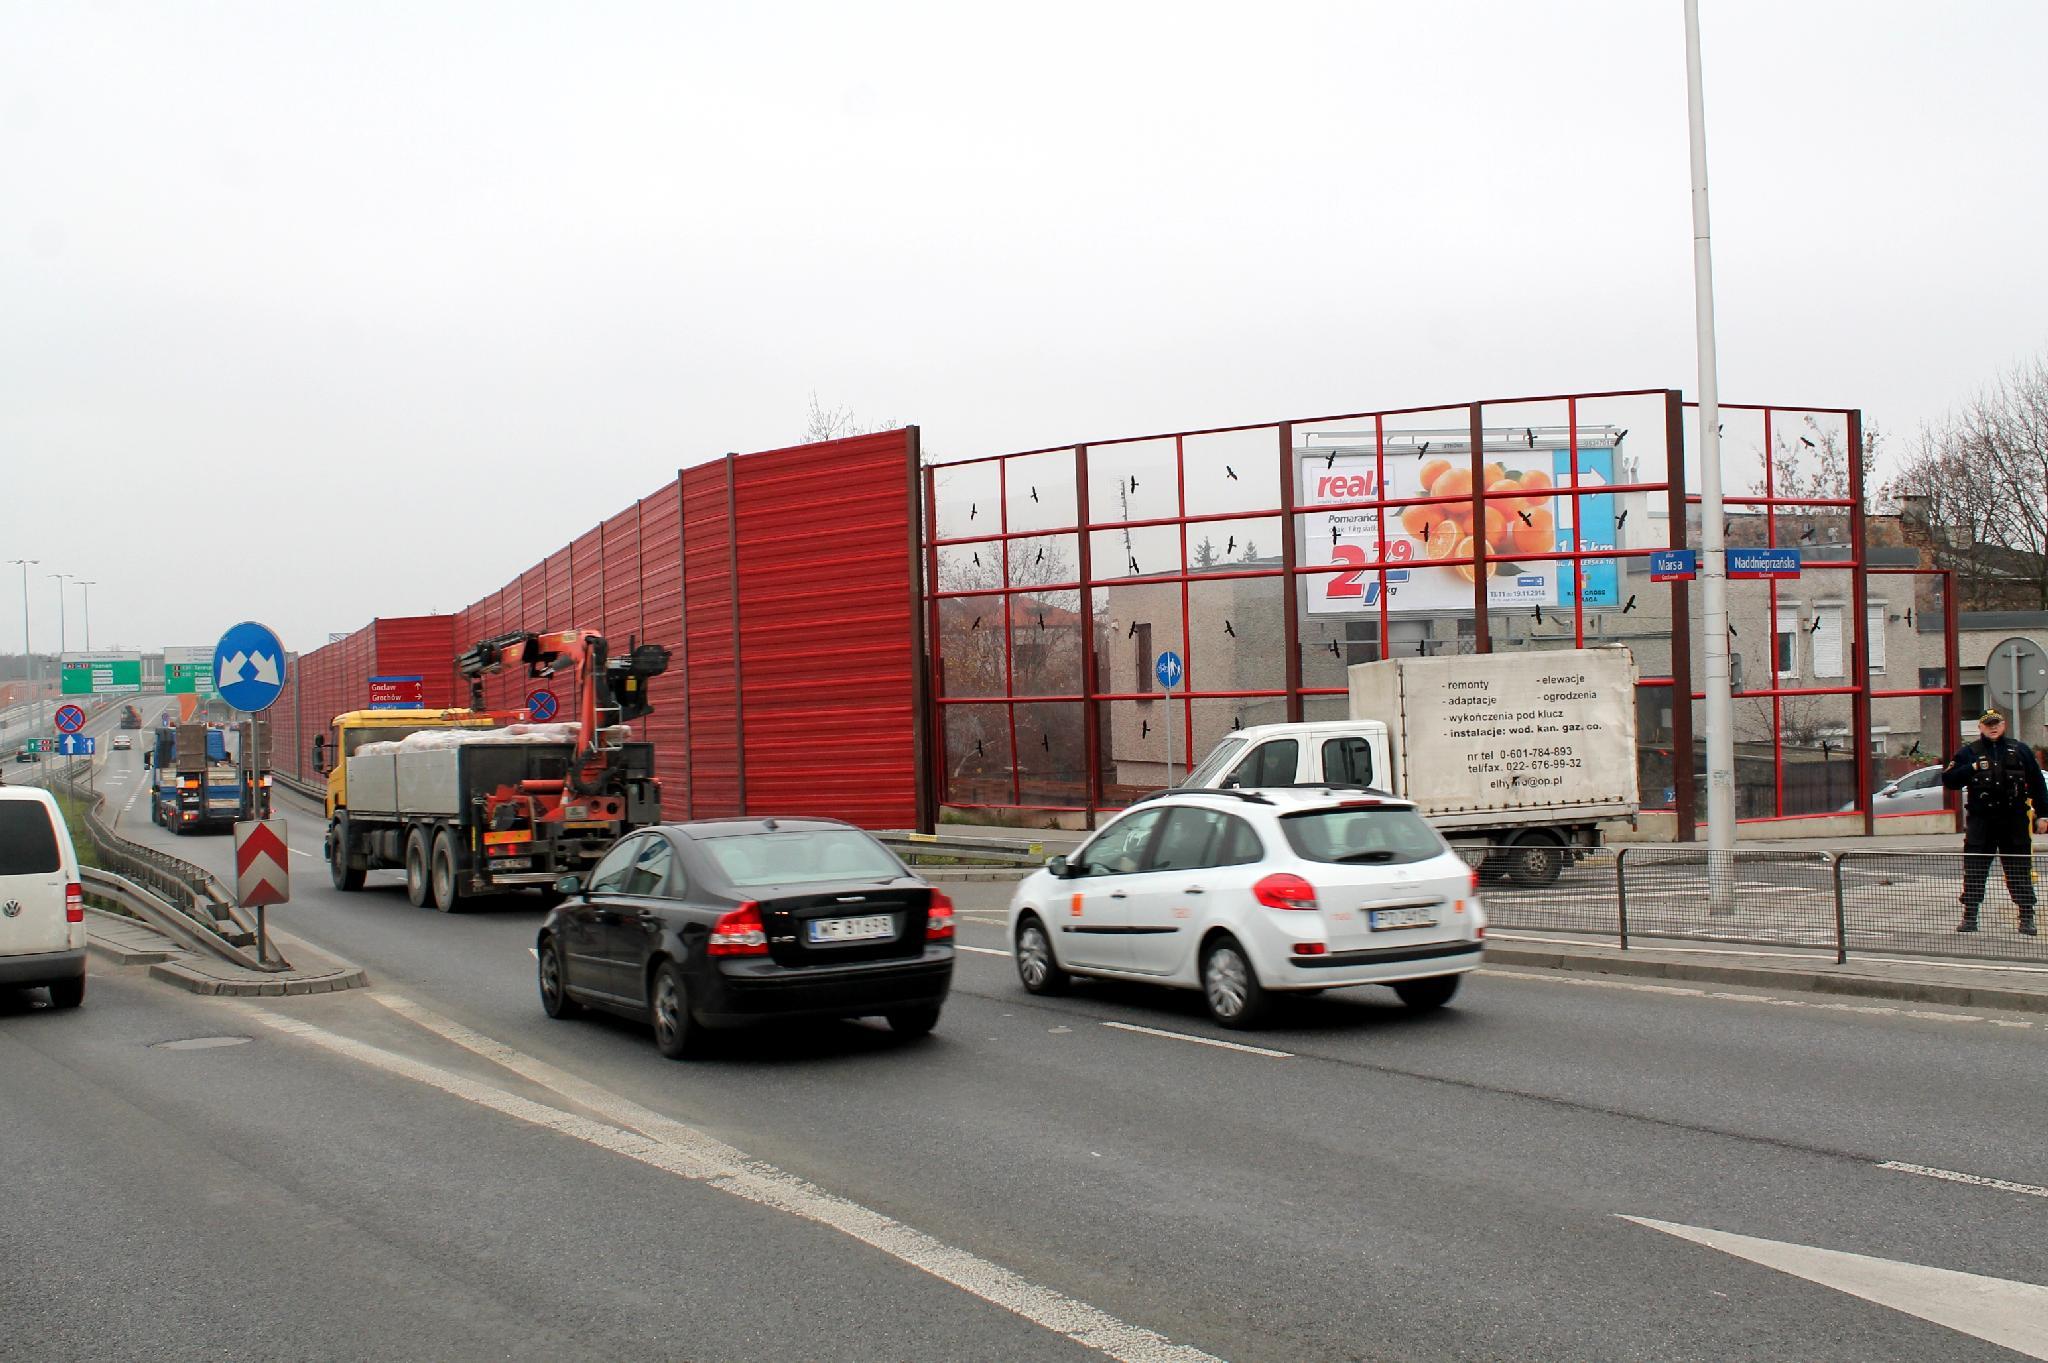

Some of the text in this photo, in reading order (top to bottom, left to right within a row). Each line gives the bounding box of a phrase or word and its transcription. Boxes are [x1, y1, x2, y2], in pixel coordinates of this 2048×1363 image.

[1658, 559, 1683, 571] Marsa
[1734, 556, 1795, 571] Naddnieprzańska
[1448, 680, 1489, 691] remonty
[1542, 674, 1585, 686] elewacje
[372, 693, 402, 701] Grochów
[1448, 694, 1497, 707] adaptacje
[1543, 690, 1597, 703] ogrodzenia
[1449, 709, 1564, 724] wykończenia pod klucz
[1450, 723, 1603, 739] instalacje: wod. kan. gaz. co.
[1467, 746, 1573, 761] nr tel 0-601-784-893
[1468, 763, 1503, 774] tel/fax.
